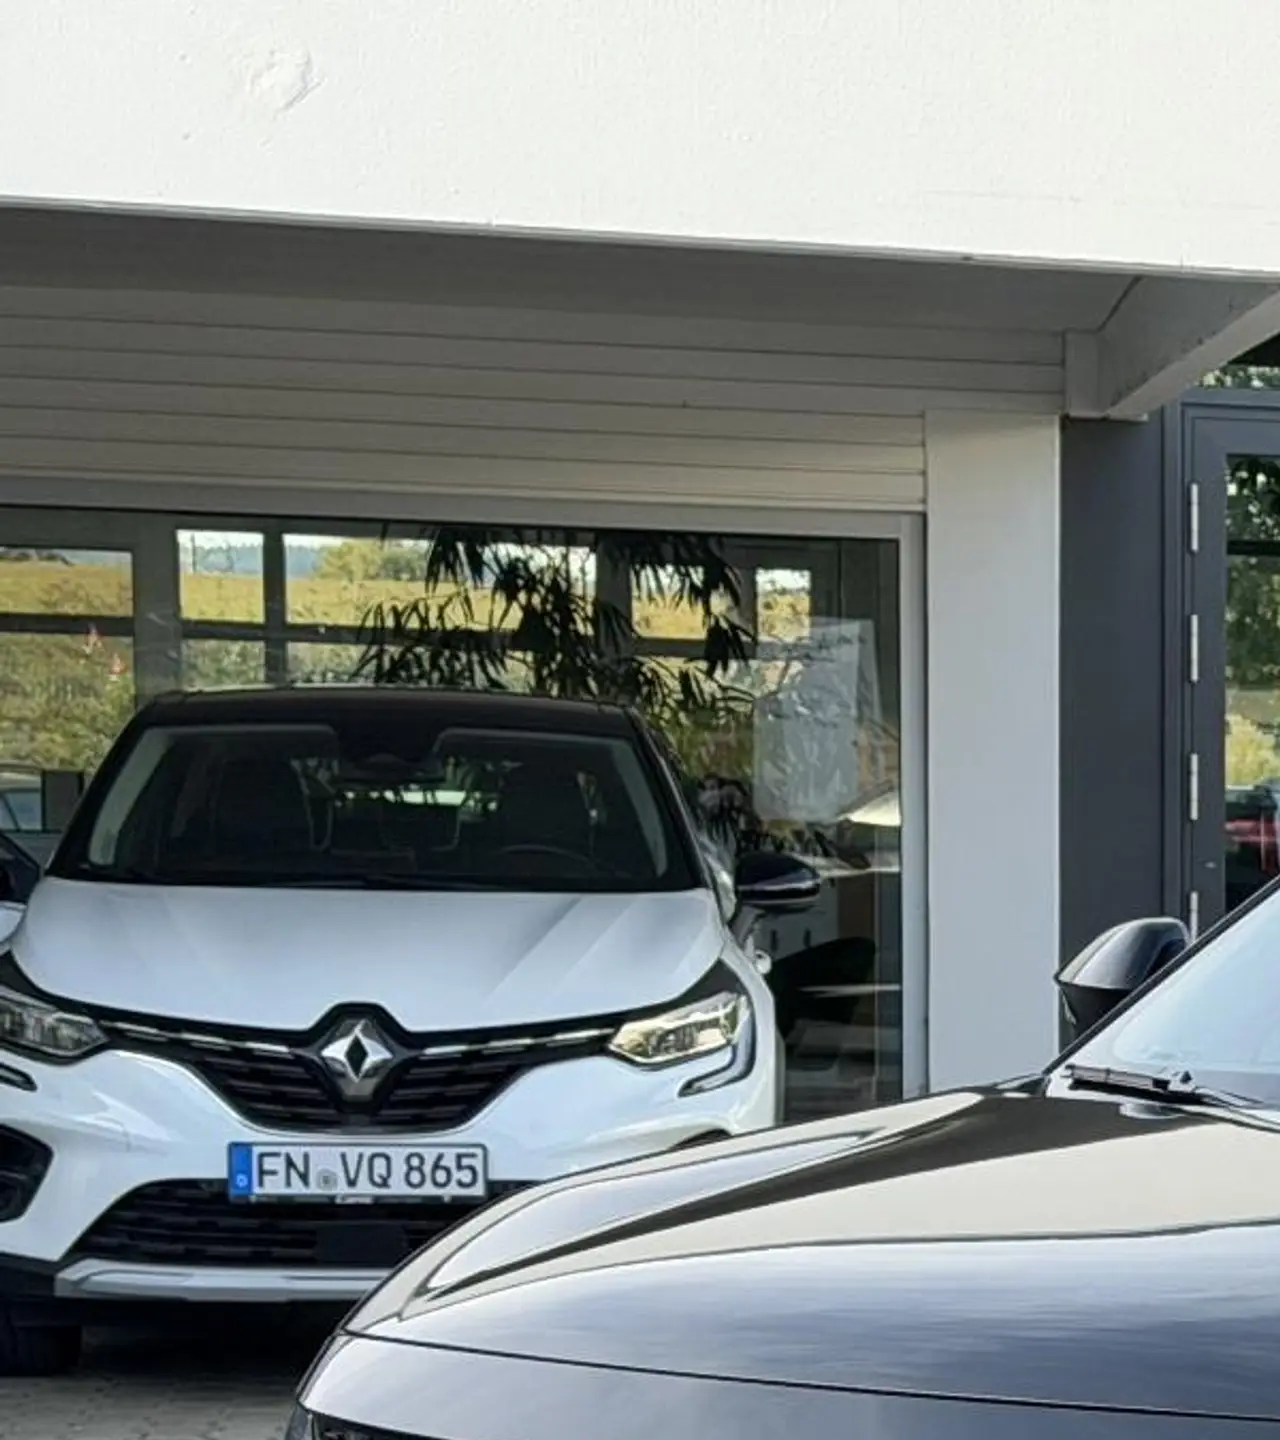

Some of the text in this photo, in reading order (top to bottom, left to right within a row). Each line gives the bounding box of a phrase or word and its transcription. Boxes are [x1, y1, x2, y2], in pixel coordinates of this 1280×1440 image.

[257, 1152, 478, 1189] FN VQ 865
